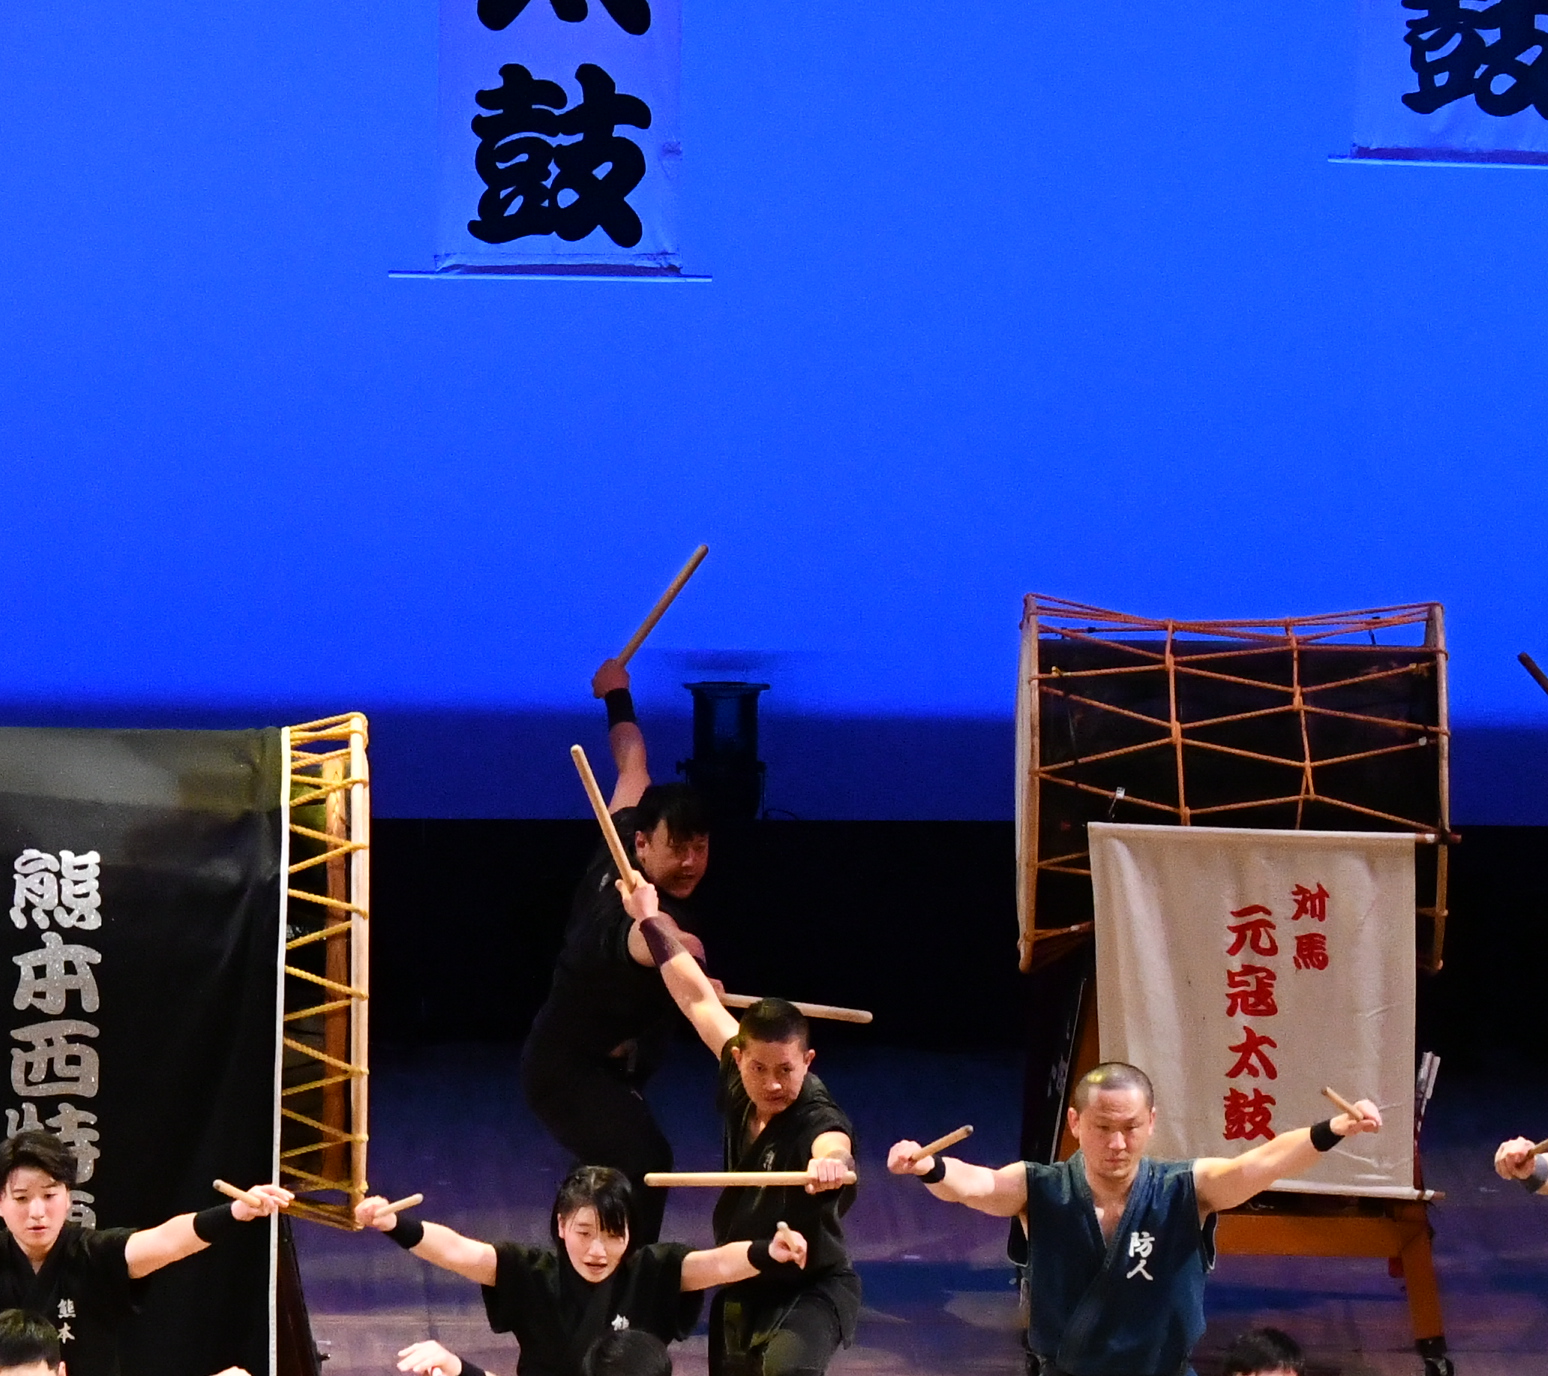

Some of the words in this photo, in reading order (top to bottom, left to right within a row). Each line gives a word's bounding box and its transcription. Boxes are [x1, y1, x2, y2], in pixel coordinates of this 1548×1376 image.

[1291, 882, 1330, 971] 対馬
[5, 848, 102, 1230] 熊本西特
[1222, 903, 1279, 1141] 元寇太鼓
[1127, 1231, 1156, 1281] 防人
[57, 1299, 77, 1344] 熊本
